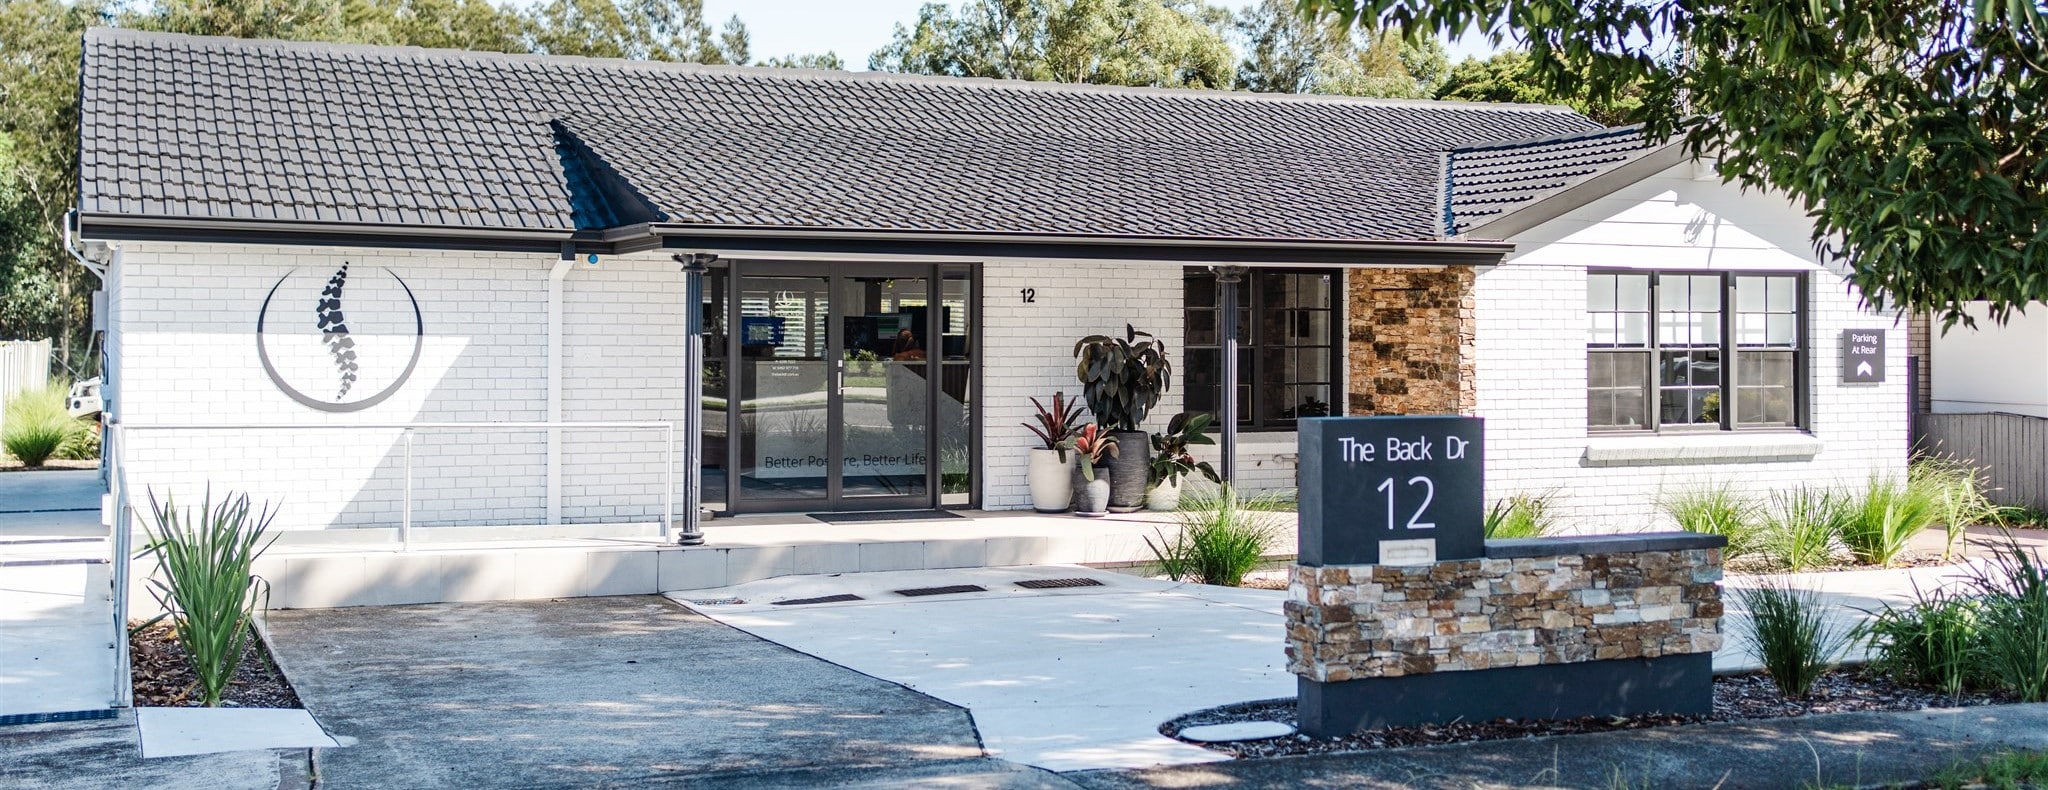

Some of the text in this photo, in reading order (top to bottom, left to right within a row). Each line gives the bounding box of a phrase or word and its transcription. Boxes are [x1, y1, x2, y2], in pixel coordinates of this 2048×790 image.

[1021, 287, 1035, 303] 12
[1852, 334, 1877, 344] Parking
[1852, 346, 1877, 355] At Rear
[1338, 436, 1469, 462] The Back Dr
[765, 455, 803, 468] Better
[863, 453, 901, 466] Better
[904, 452, 926, 465] Life
[1377, 476, 1436, 530] 12
